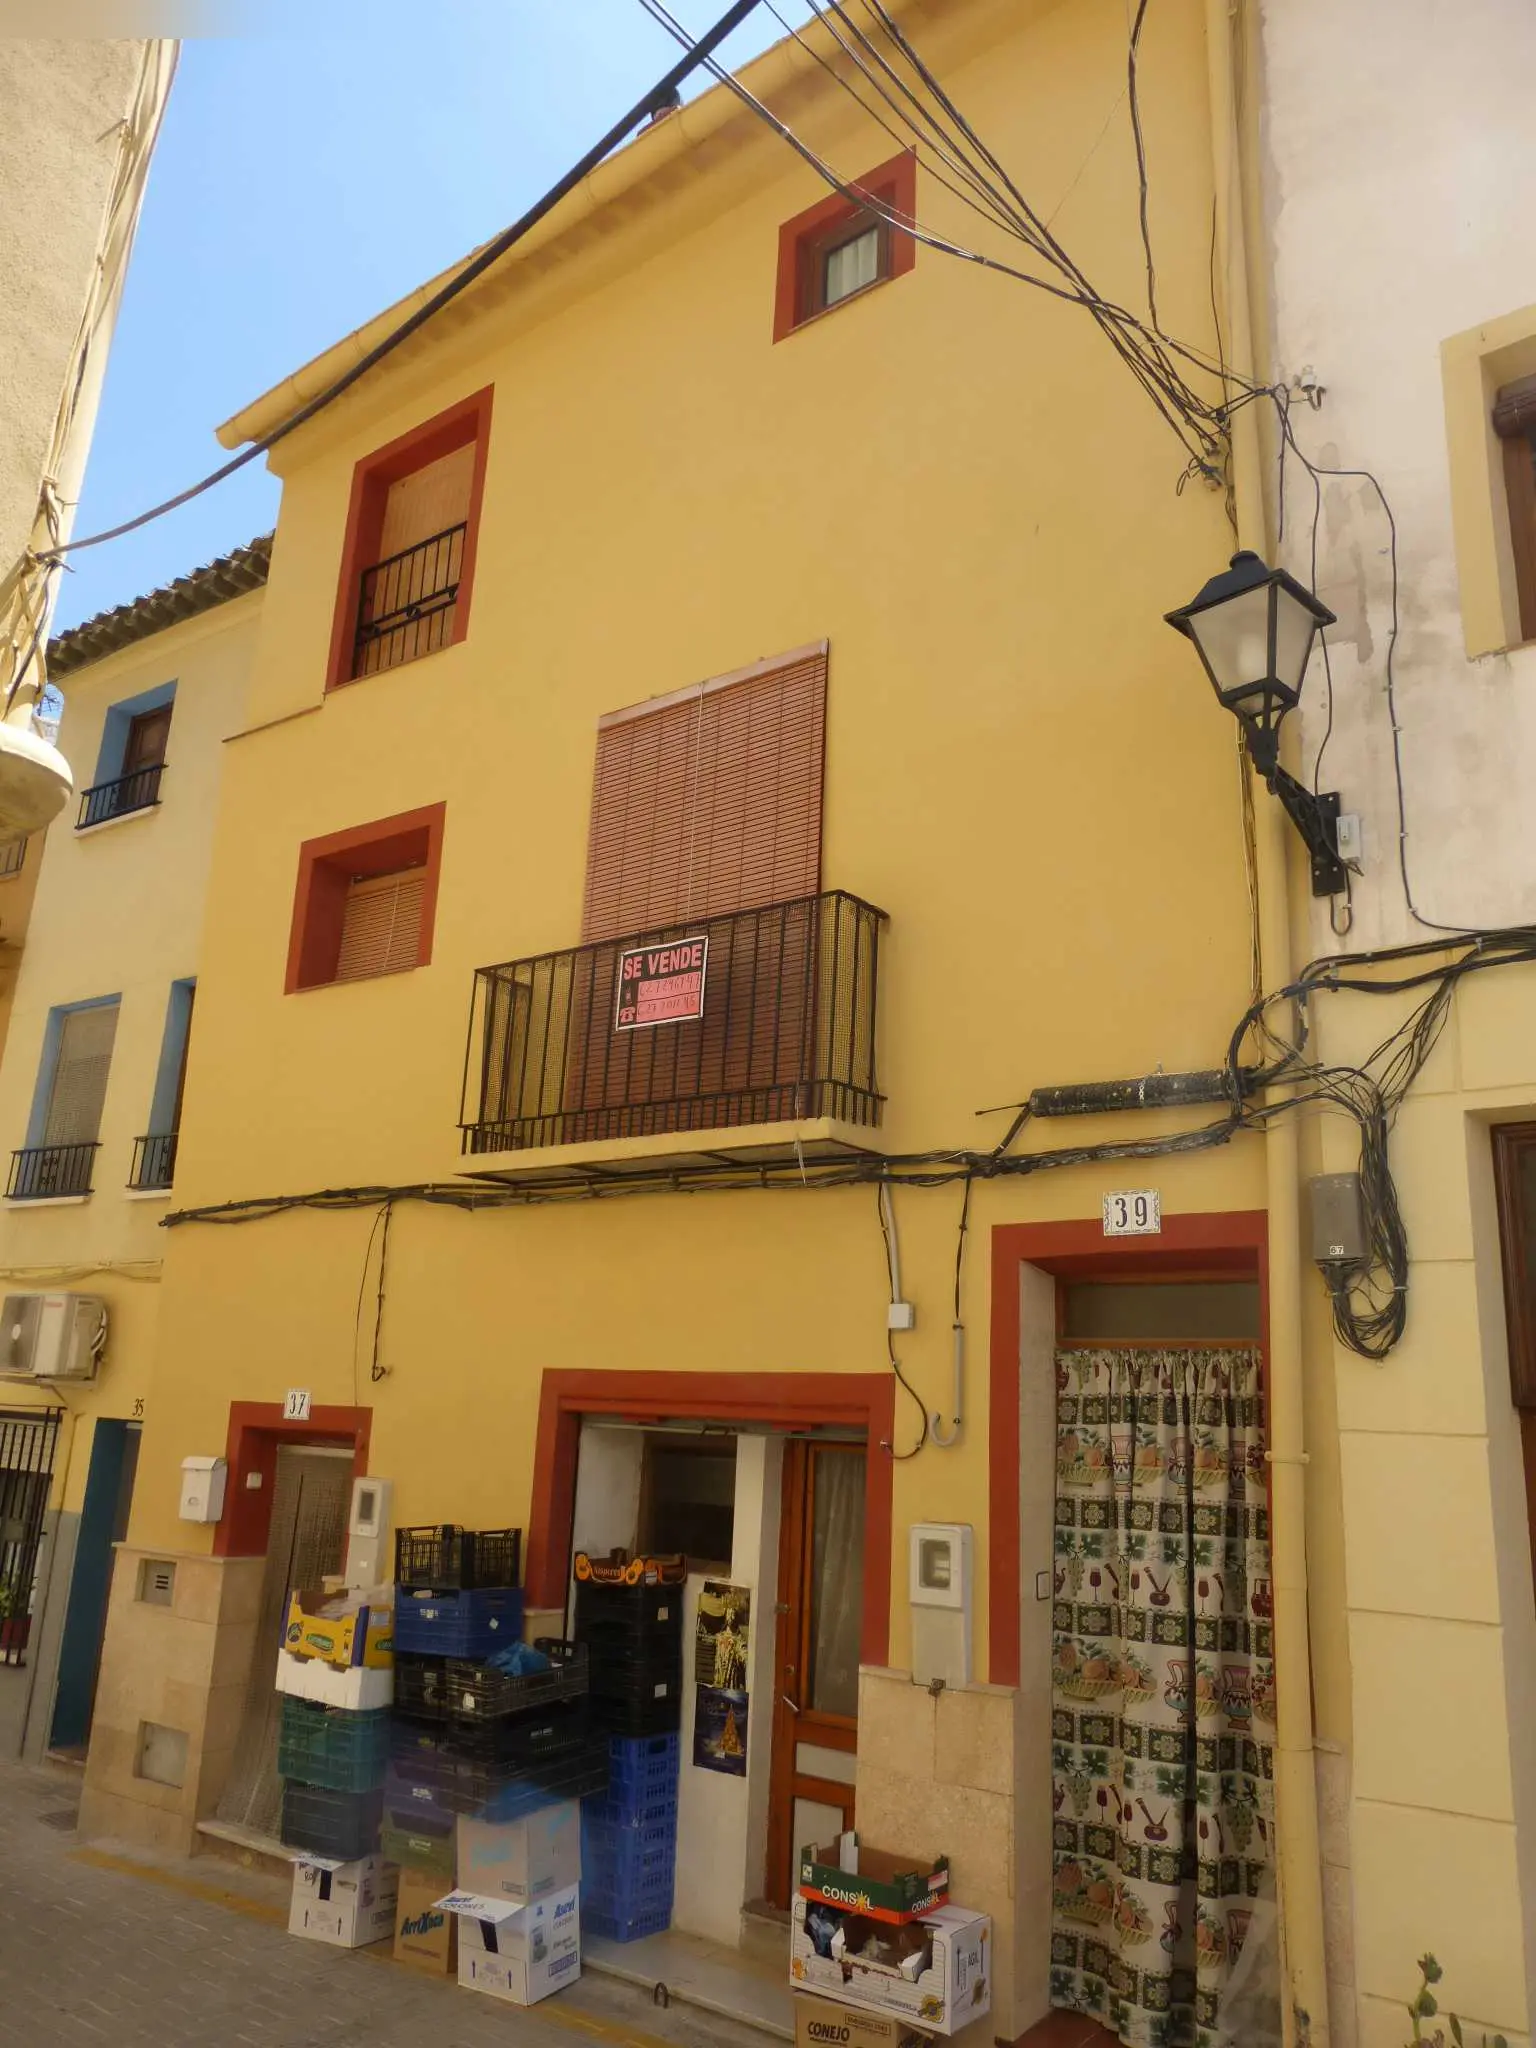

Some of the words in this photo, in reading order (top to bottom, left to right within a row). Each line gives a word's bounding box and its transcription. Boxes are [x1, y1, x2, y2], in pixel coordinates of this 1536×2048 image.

[624, 956, 642, 980] SE
[648, 944, 703, 975] VENDE
[1115, 1196, 1147, 1228] 39
[132, 1398, 144, 1416] 35
[289, 1393, 307, 1415] 37
[822, 1884, 875, 1911] CONSL
[911, 1890, 941, 1914] CONSL
[807, 2021, 850, 2042] CONEJO
